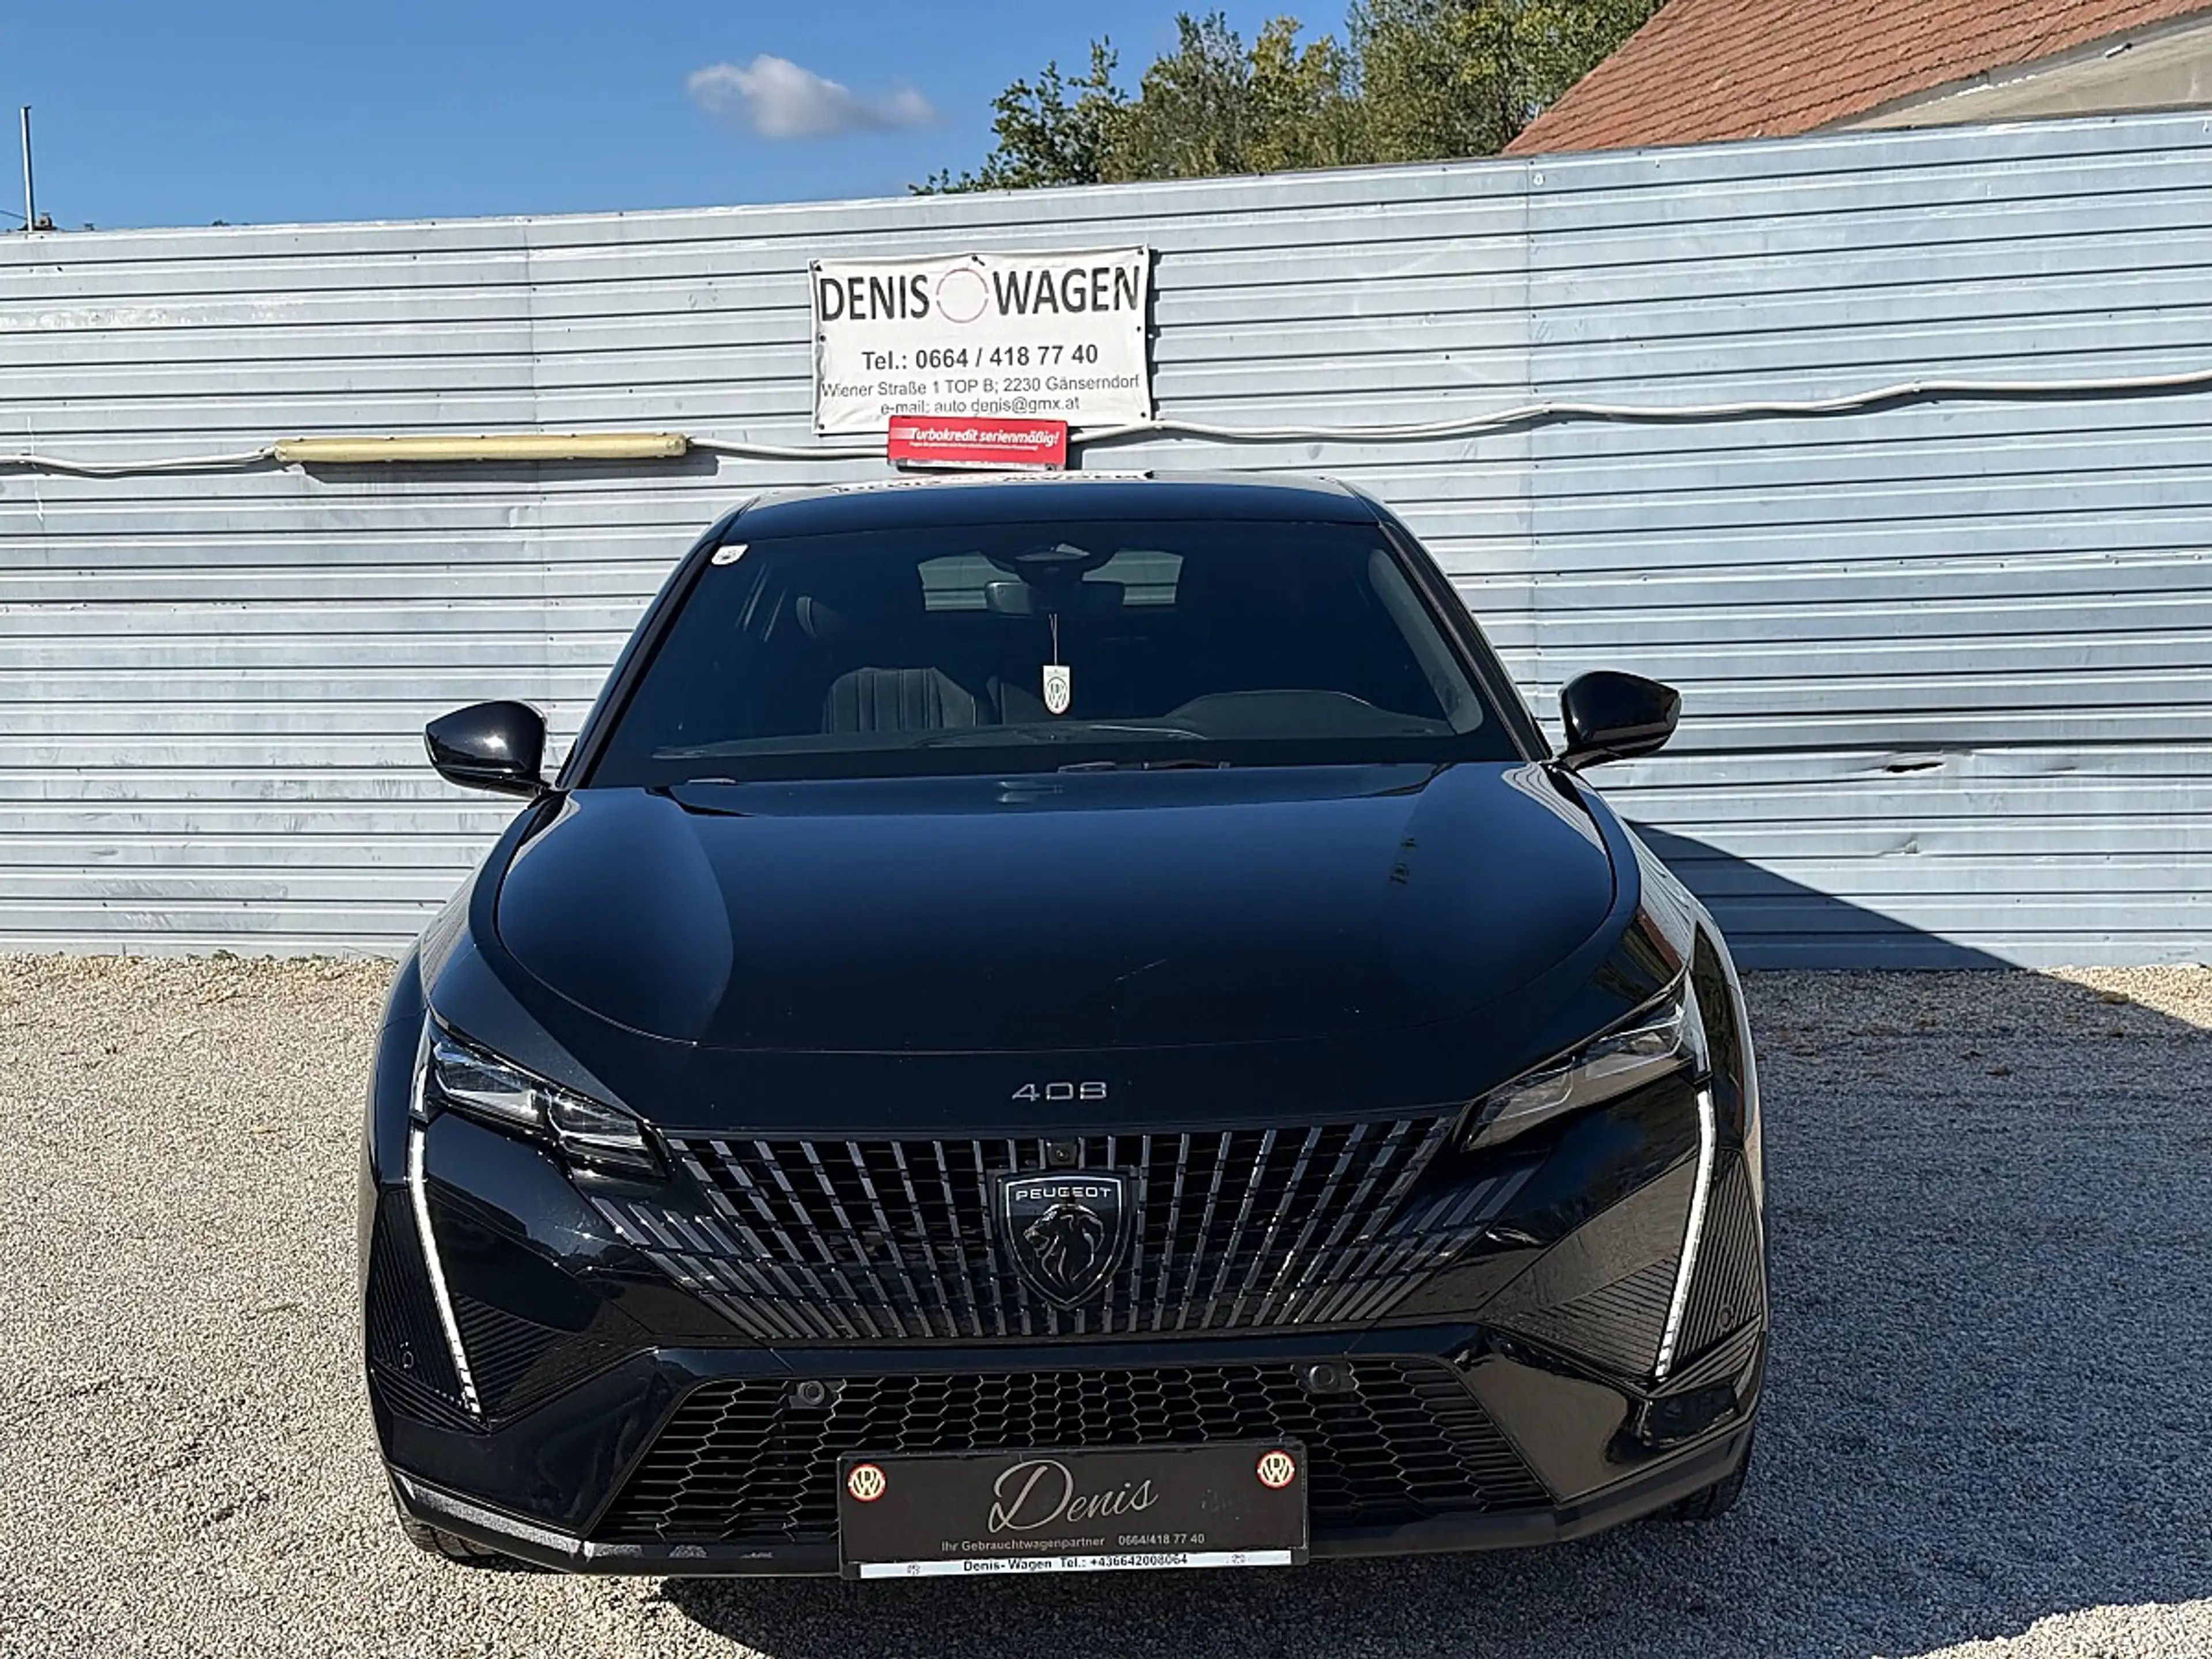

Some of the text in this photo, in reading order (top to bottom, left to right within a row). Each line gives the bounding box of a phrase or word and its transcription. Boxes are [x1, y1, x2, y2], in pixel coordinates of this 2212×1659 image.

[819, 266, 1139, 322] DENIS WAGEN
[861, 344, 1099, 370] Tel.: 0664 / 418 77 40
[821, 374, 1139, 397] Wiener Straße 1 TOP B; 2230 Gänserndorf
[1012, 1082, 1107, 1101] 408
[1016, 1187, 1112, 1201] PEUGEOT
[987, 1459, 1159, 1533] Denis
[941, 1541, 957, 1551] Ihr
[961, 1537, 1105, 1552] Gebrauchtwagenpartner
[1173, 1533, 1187, 1544] 77
[1190, 1532, 1205, 1544] 40
[1009, 1559, 1052, 1571] Wagen
[1060, 1557, 1086, 1569] Tel.:
